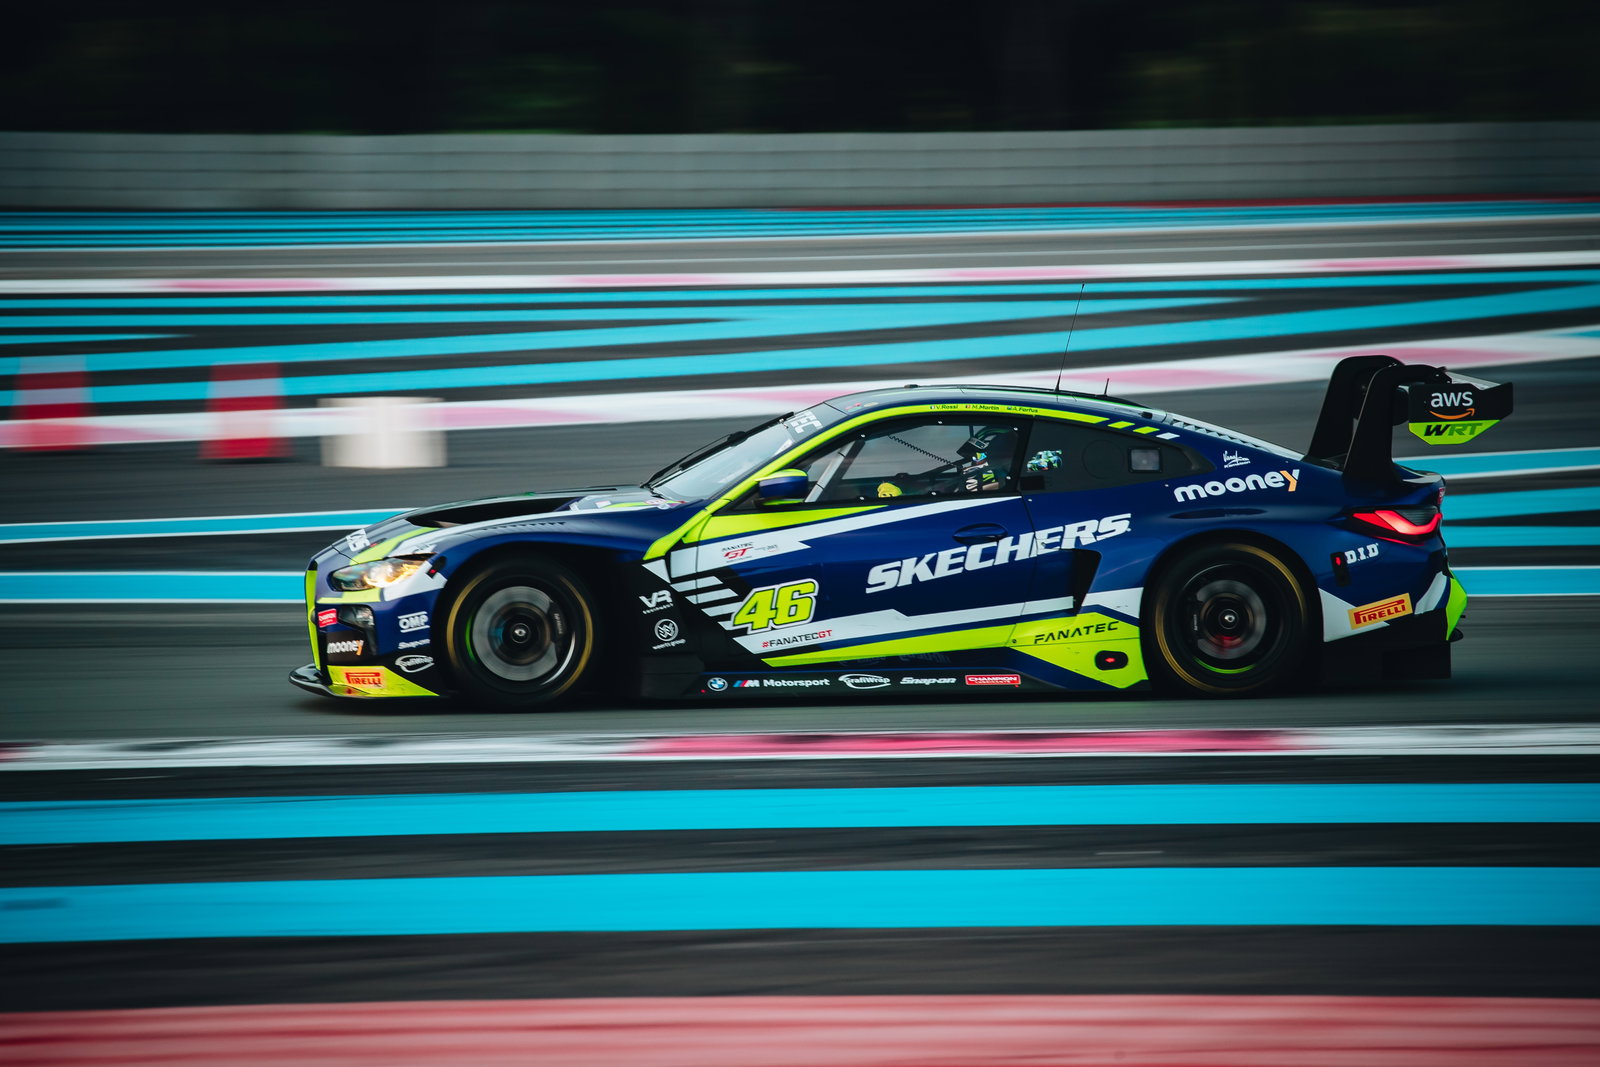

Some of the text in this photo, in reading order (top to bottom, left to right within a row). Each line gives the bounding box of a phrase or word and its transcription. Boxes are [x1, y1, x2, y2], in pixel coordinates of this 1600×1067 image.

[1430, 391, 1474, 408] aws
[1424, 422, 1483, 437] WRT
[1173, 469, 1300, 503] mooney
[723, 546, 754, 560] GT
[865, 513, 1131, 594] SKECHERS
[638, 590, 673, 608] VR
[731, 579, 818, 633] 46
[1353, 599, 1406, 625] PIRELLI
[398, 613, 429, 630] OMP
[761, 629, 833, 648] #FANATECGT
[1034, 620, 1119, 645] FANATEC
[326, 639, 365, 656] mooney
[345, 671, 382, 685] PIRELLI
[763, 678, 831, 688] Motorsport
[899, 676, 957, 686] Snap-on
